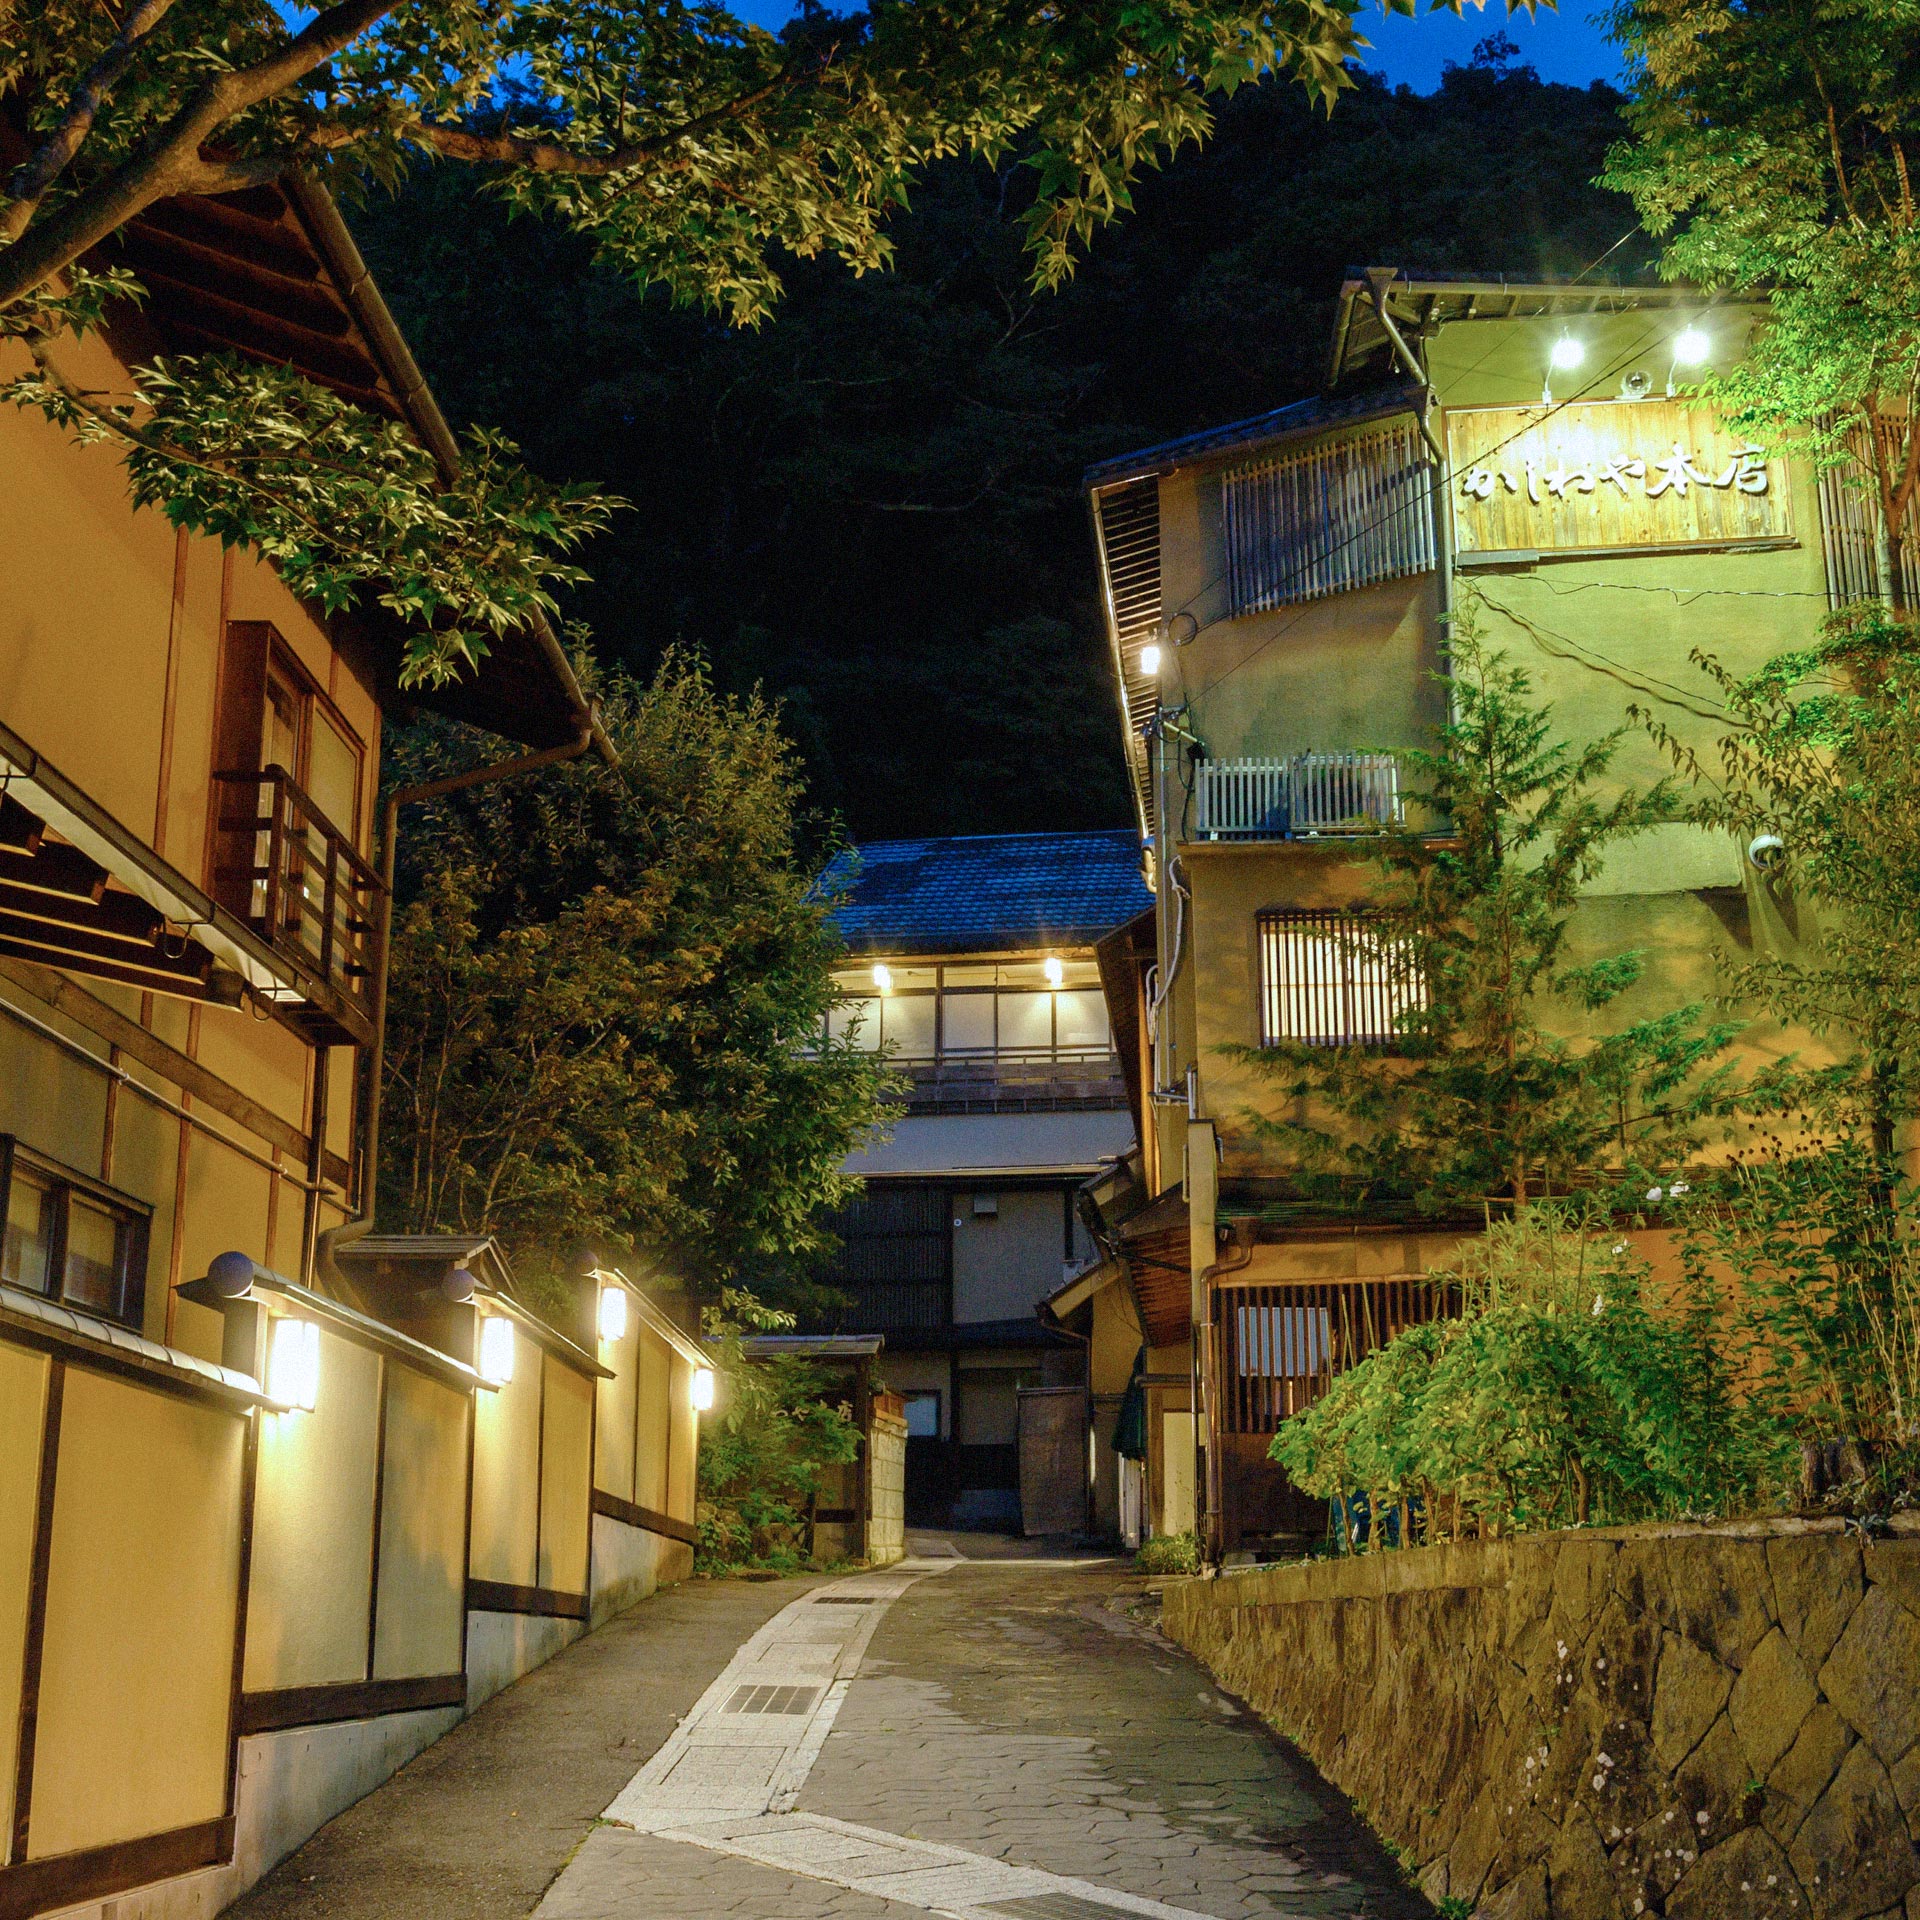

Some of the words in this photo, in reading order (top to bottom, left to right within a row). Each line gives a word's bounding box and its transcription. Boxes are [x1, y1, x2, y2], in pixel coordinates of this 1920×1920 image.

[1461, 442, 1768, 505] かしわや本店
